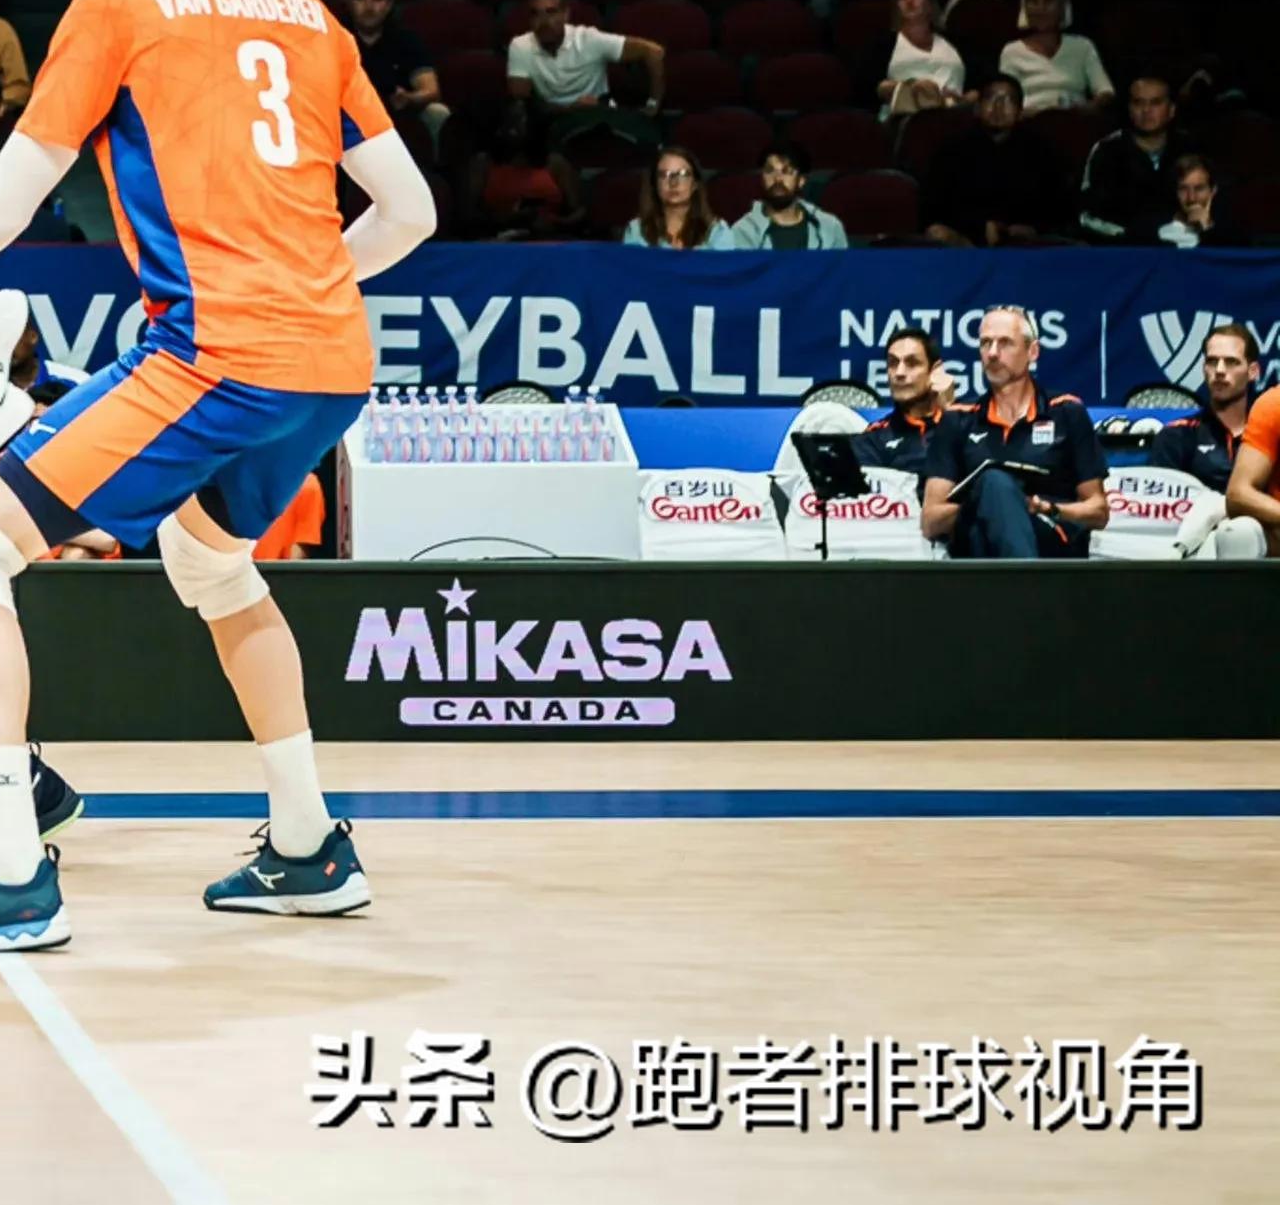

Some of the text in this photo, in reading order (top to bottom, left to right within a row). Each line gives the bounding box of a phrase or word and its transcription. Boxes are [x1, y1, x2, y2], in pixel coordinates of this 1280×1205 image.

[237, 39, 299, 167] 3
[30, 294, 814, 395] VEYBALL
[839, 308, 1069, 350] NATIOS
[432, 699, 642, 722] CANADA
